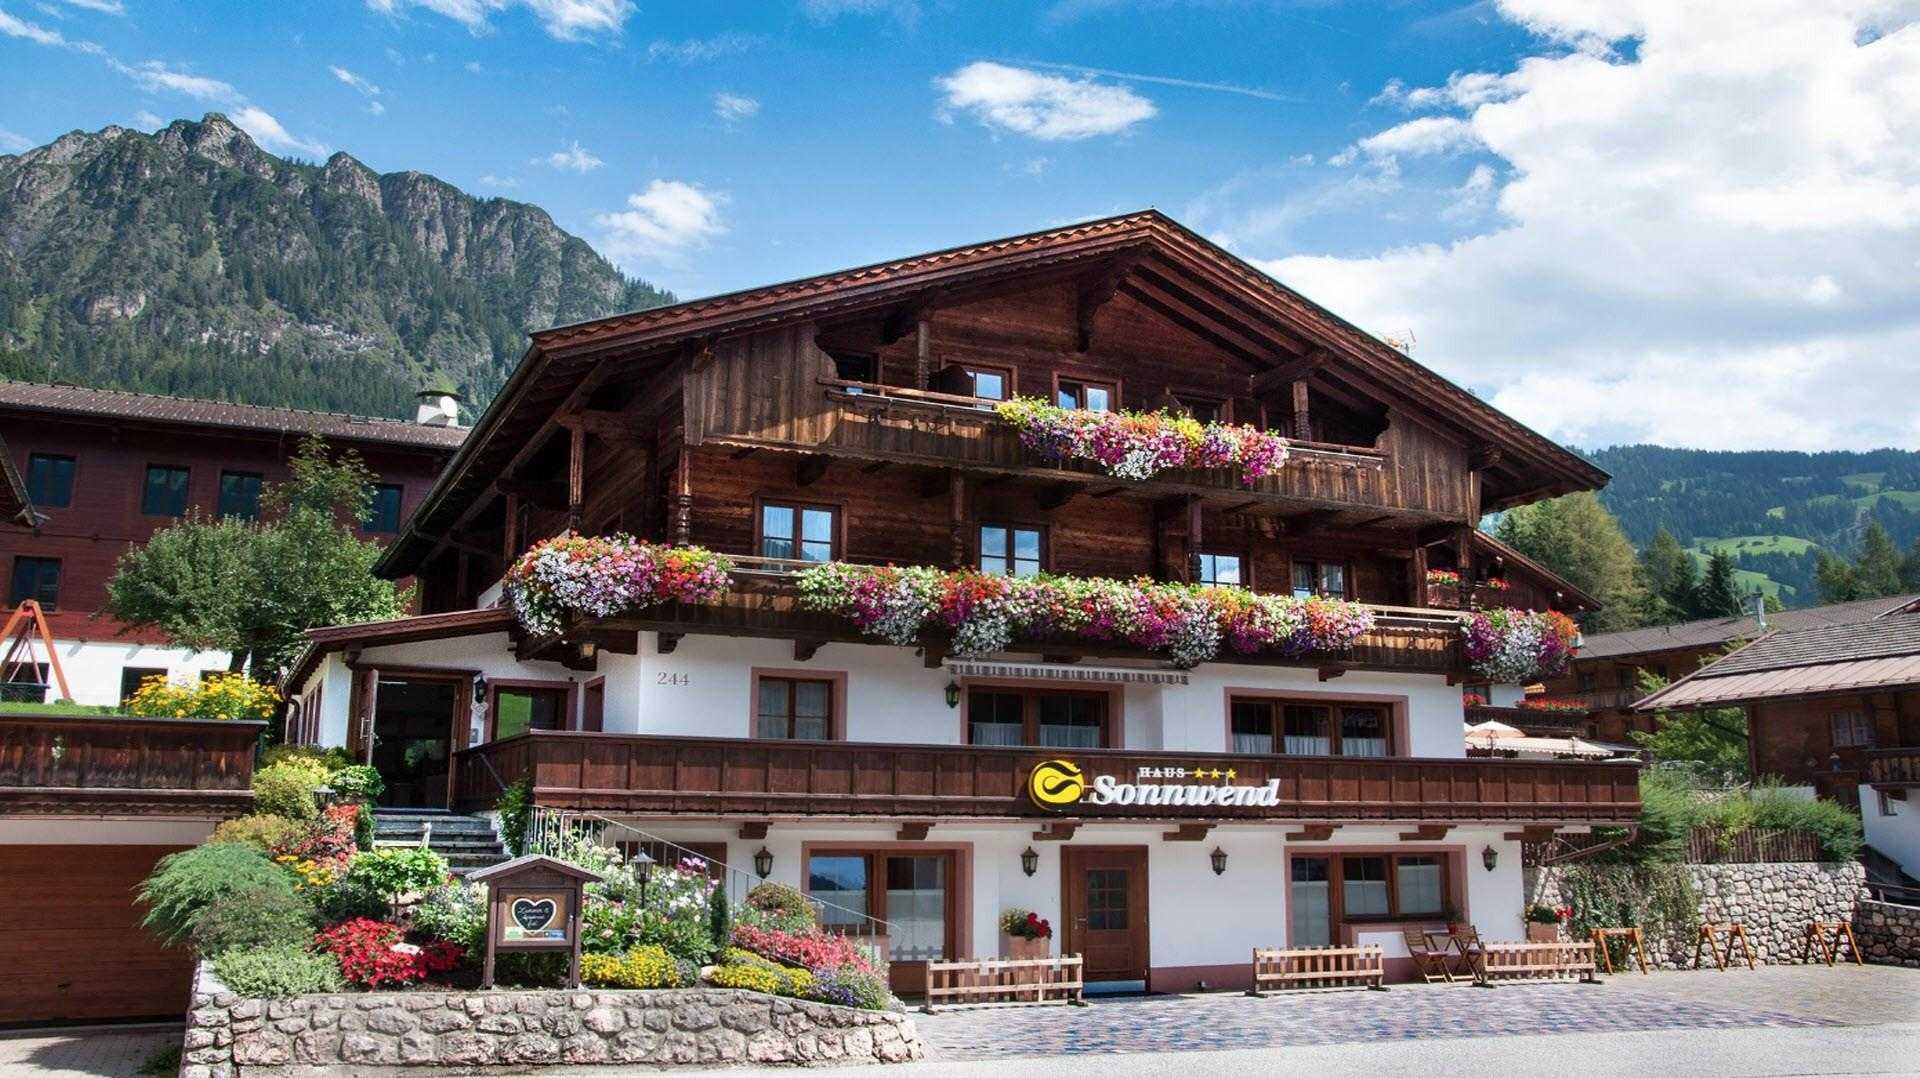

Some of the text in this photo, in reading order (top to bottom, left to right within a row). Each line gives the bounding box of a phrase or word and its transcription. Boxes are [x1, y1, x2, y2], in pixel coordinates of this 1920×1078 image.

[657, 671, 690, 686] 244
[1138, 767, 1185, 778] HAUS
[1093, 775, 1280, 806] Sonnwend
